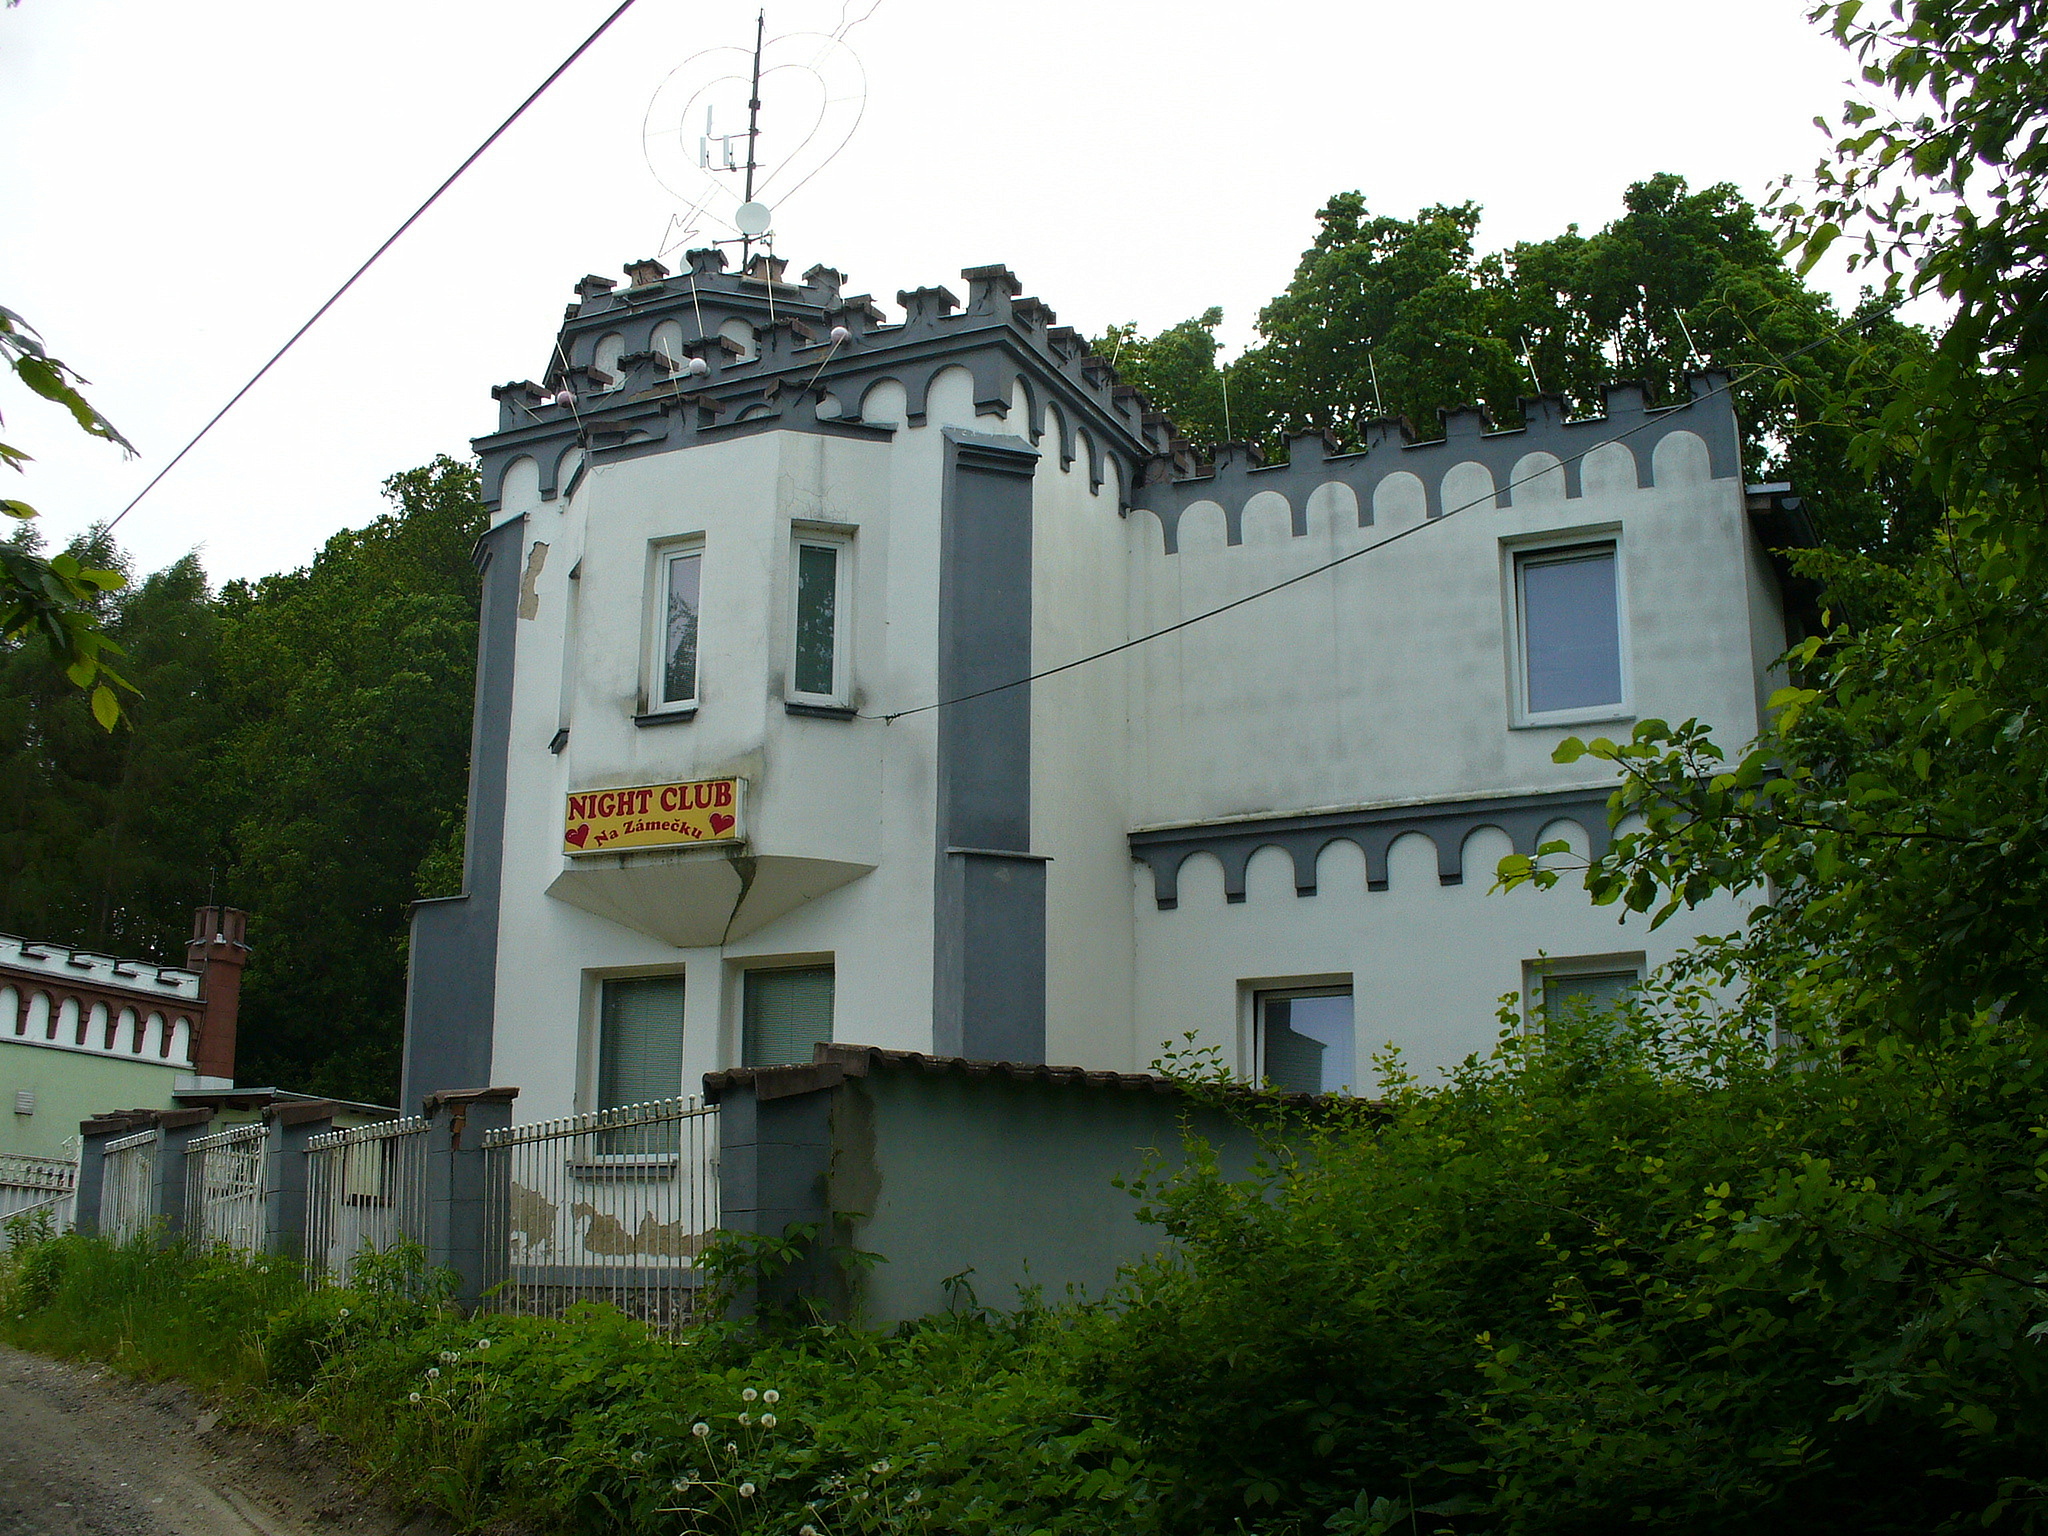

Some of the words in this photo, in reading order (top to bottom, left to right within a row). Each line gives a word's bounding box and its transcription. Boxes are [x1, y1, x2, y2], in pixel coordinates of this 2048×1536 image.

[568, 789, 653, 821] NIGHT
[660, 781, 732, 812] CLUB
[594, 829, 619, 847] Na
[623, 818, 703, 839] Zámečku
